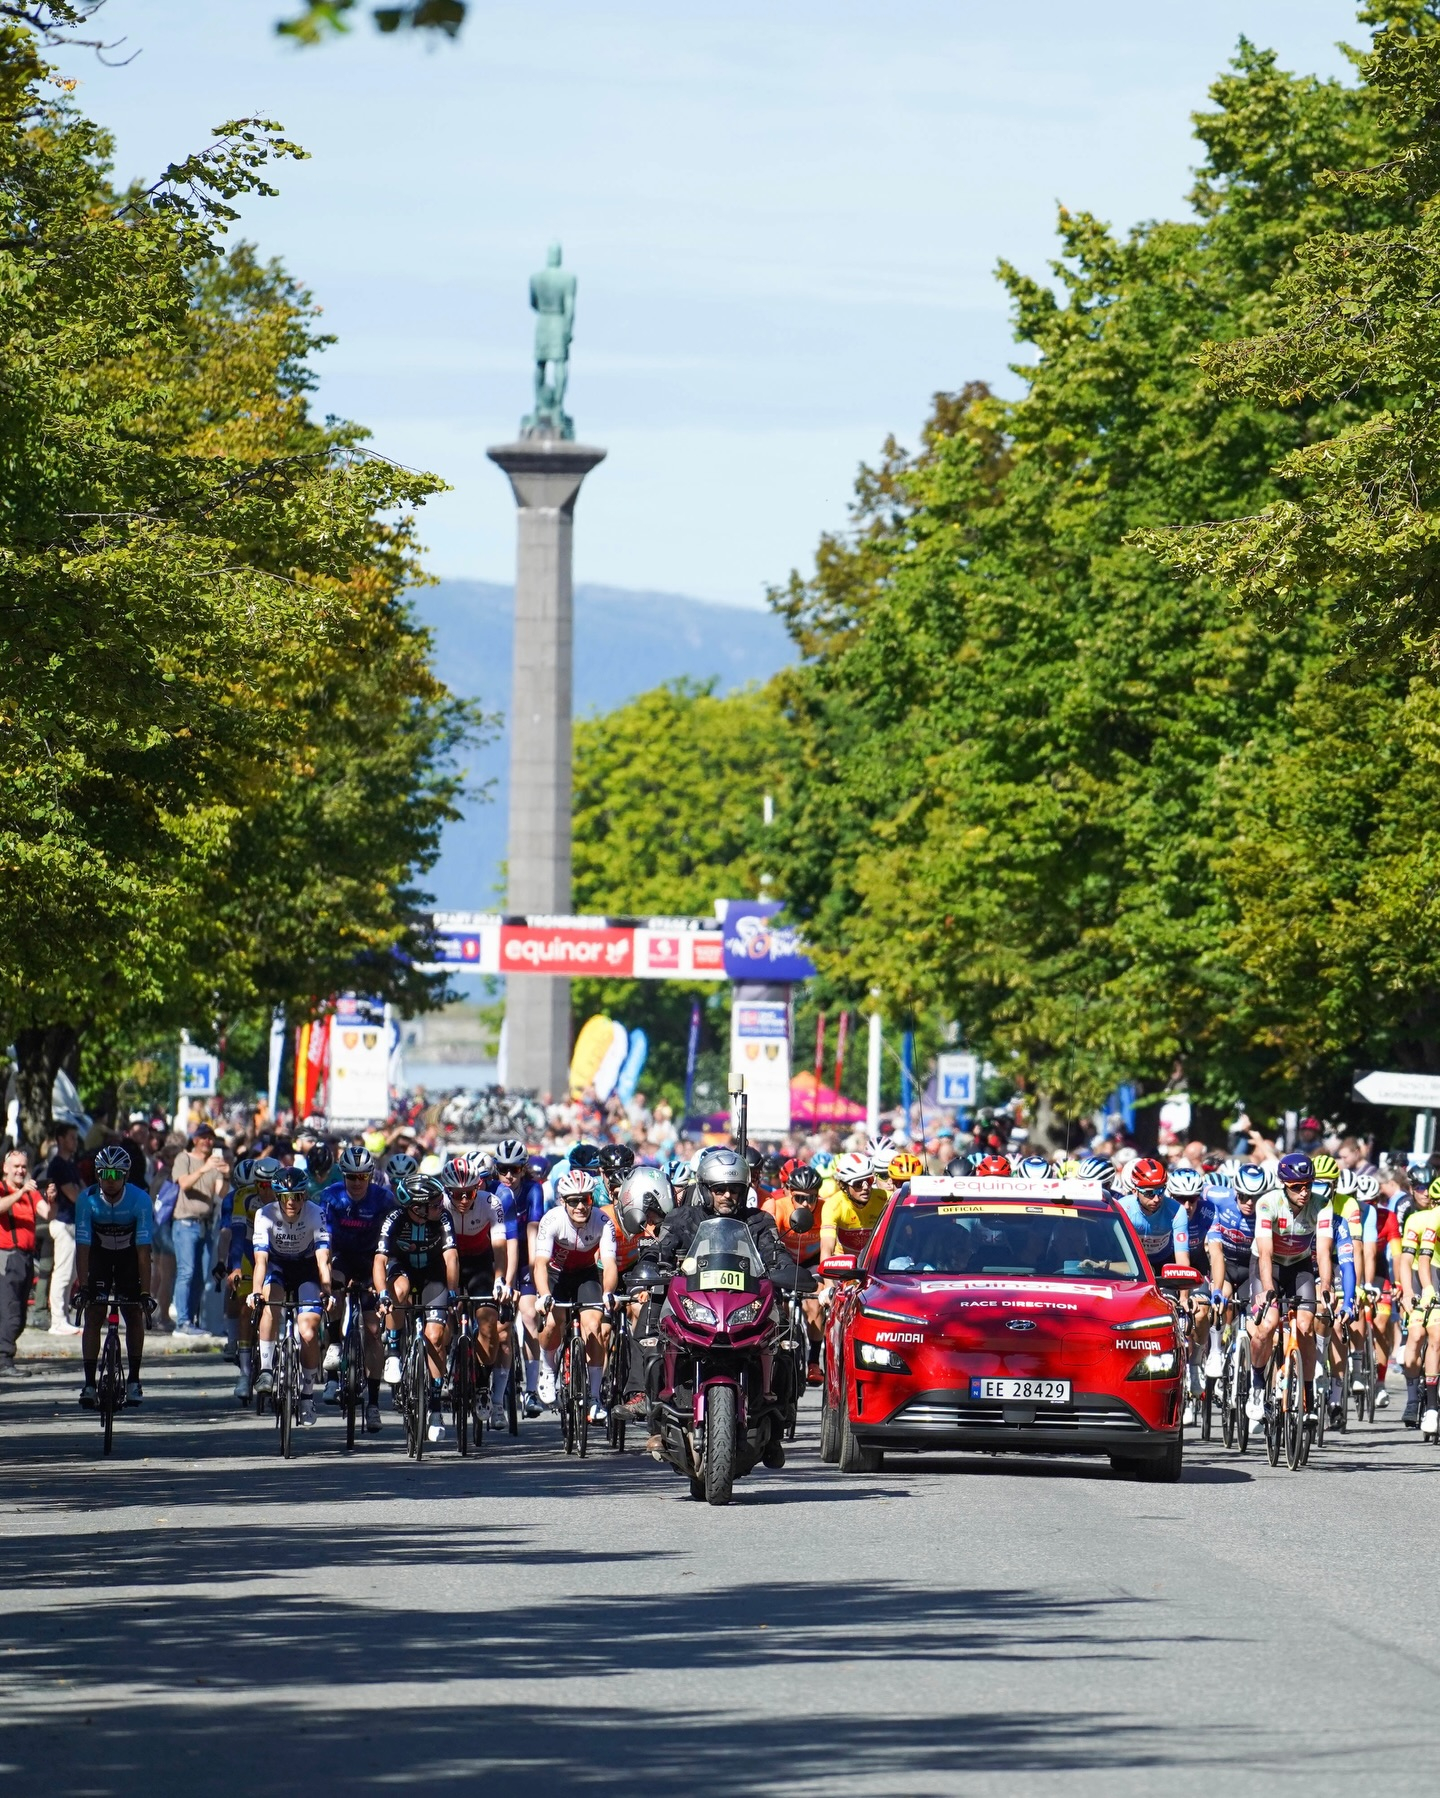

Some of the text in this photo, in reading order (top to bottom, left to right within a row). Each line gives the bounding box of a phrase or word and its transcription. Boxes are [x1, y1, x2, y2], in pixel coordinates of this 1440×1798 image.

[505, 936, 603, 966] equinor
[953, 1179, 1038, 1192] equinor
[275, 1233, 297, 1241] ISRAEL
[1223, 1229, 1252, 1243] Alpecin
[720, 1272, 740, 1286] 601
[1166, 1269, 1197, 1277] HYUNDAI
[926, 1282, 1056, 1290] equinor
[1001, 1301, 1078, 1310] DIRECTION
[875, 1332, 924, 1344] HYUNDAI
[1115, 1339, 1161, 1351] HYUNDAI
[986, 1382, 1064, 1398] EE 28429
